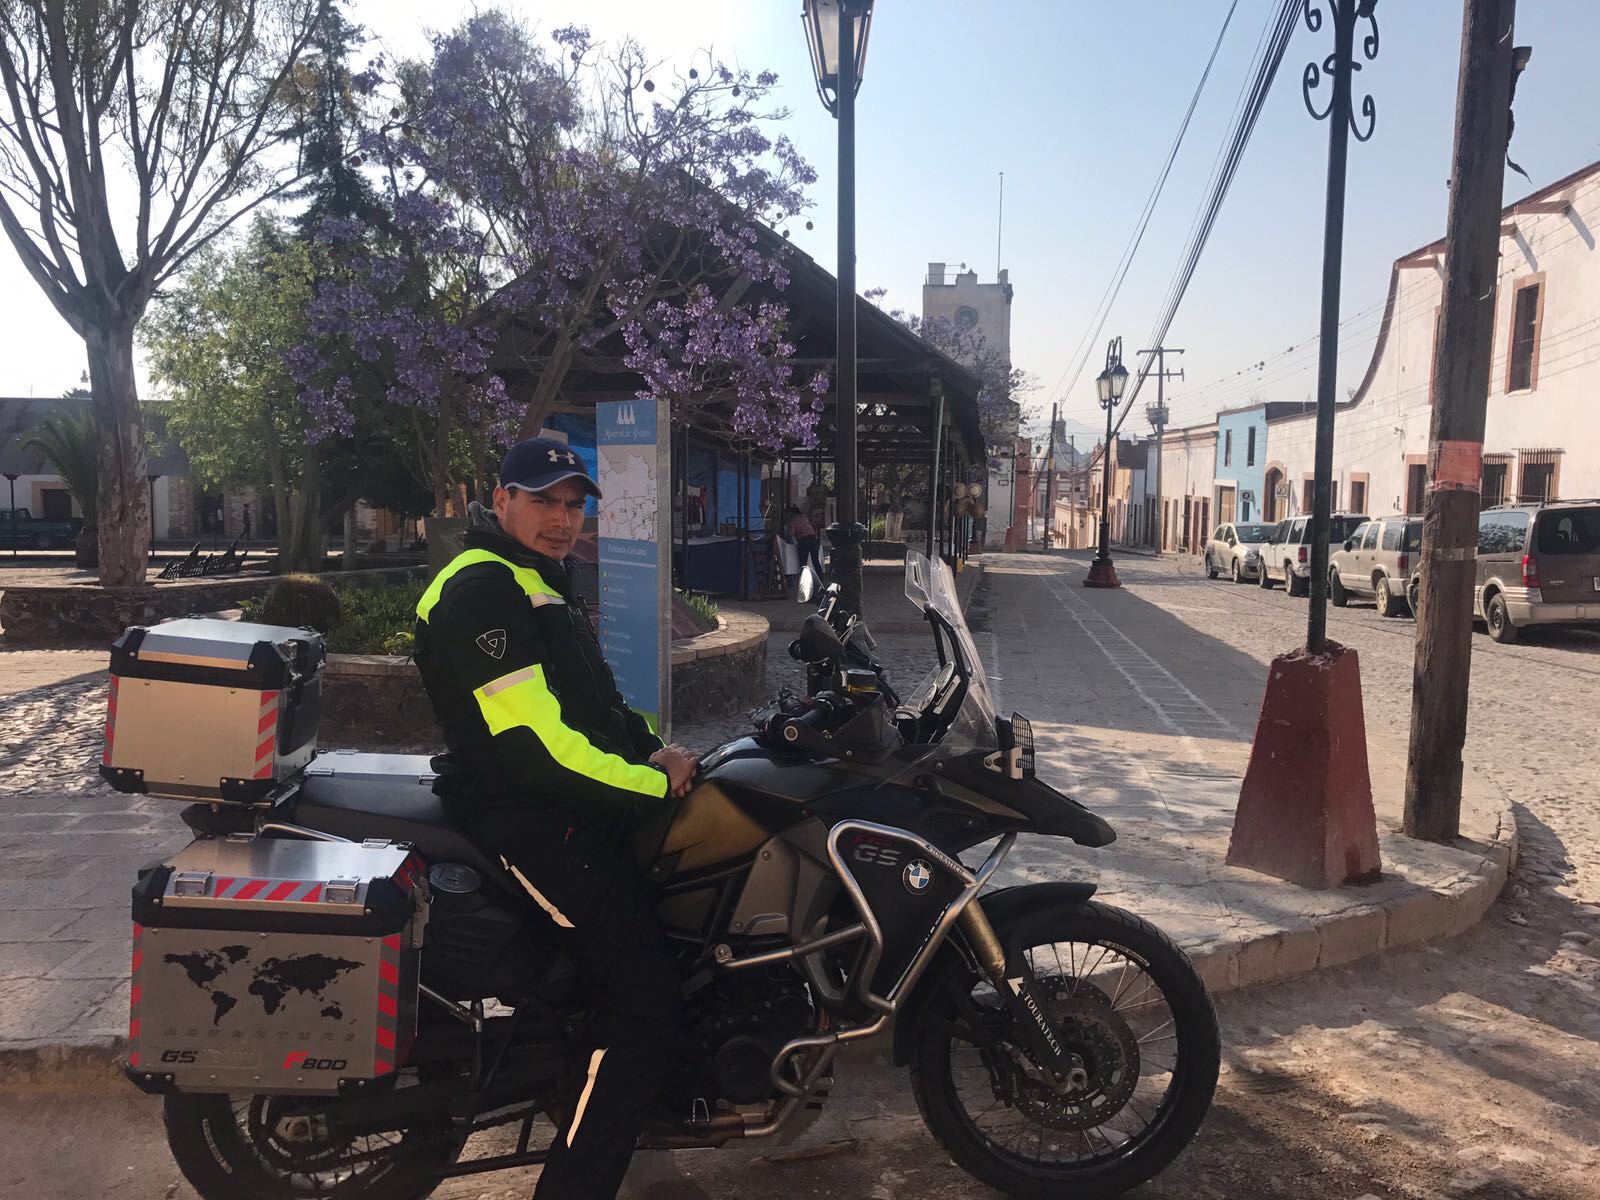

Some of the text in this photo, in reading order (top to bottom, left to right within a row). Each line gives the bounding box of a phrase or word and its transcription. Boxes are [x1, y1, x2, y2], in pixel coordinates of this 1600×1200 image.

[854, 844, 901, 866] GS
[1023, 992, 1062, 1057] TOURATECH
[160, 1050, 198, 1064] GS
[283, 1050, 348, 1071] F800
